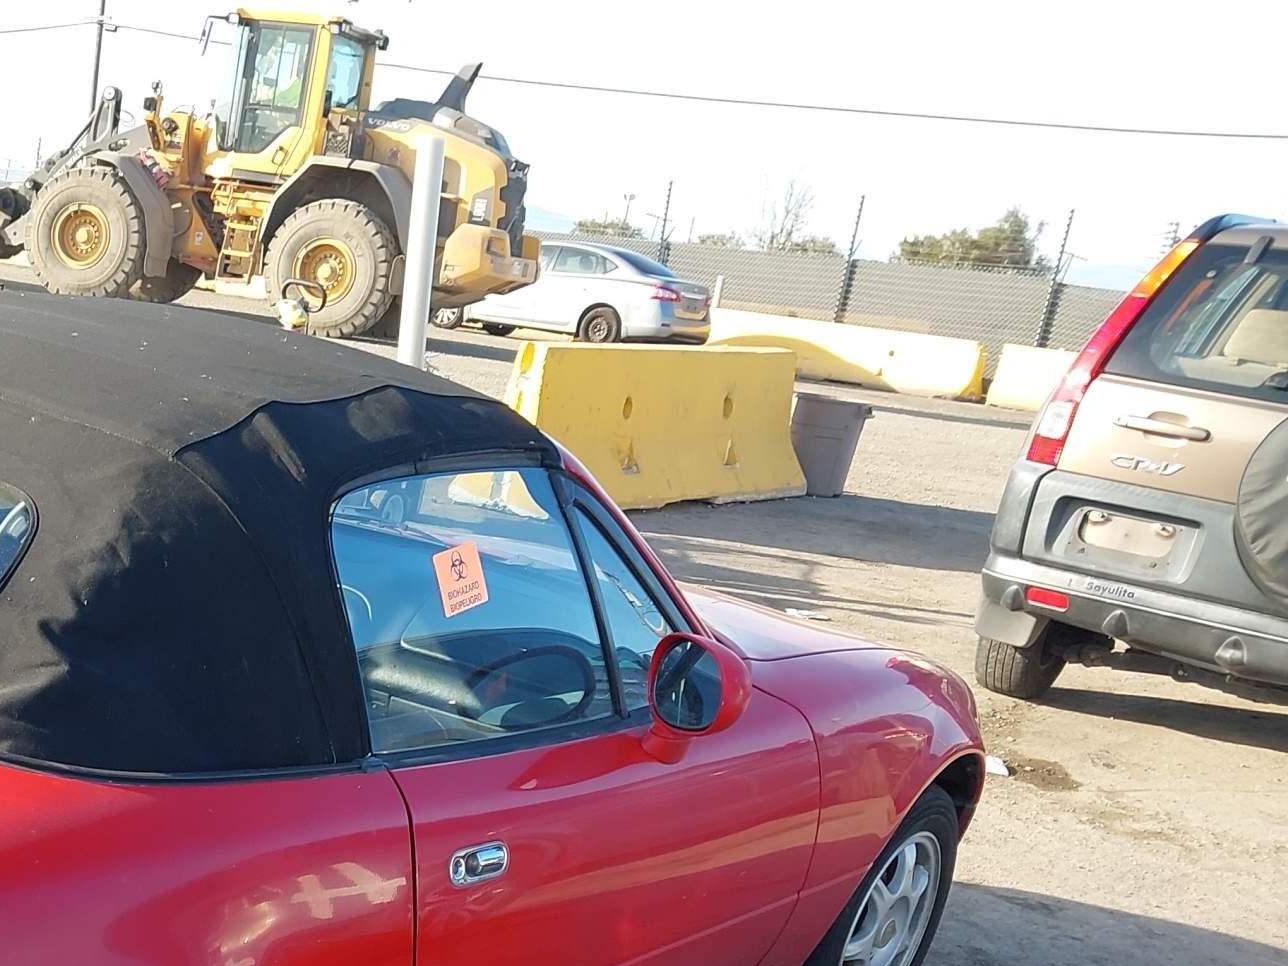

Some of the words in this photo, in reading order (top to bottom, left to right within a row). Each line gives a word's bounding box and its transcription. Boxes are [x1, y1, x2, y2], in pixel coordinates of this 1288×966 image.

[367, 117, 411, 130] VOLVO
[447, 580, 480, 601] BIOHAZARD
[1086, 581, 1137, 599] Sayulita
[450, 592, 482, 613] BIOPELIGRO
